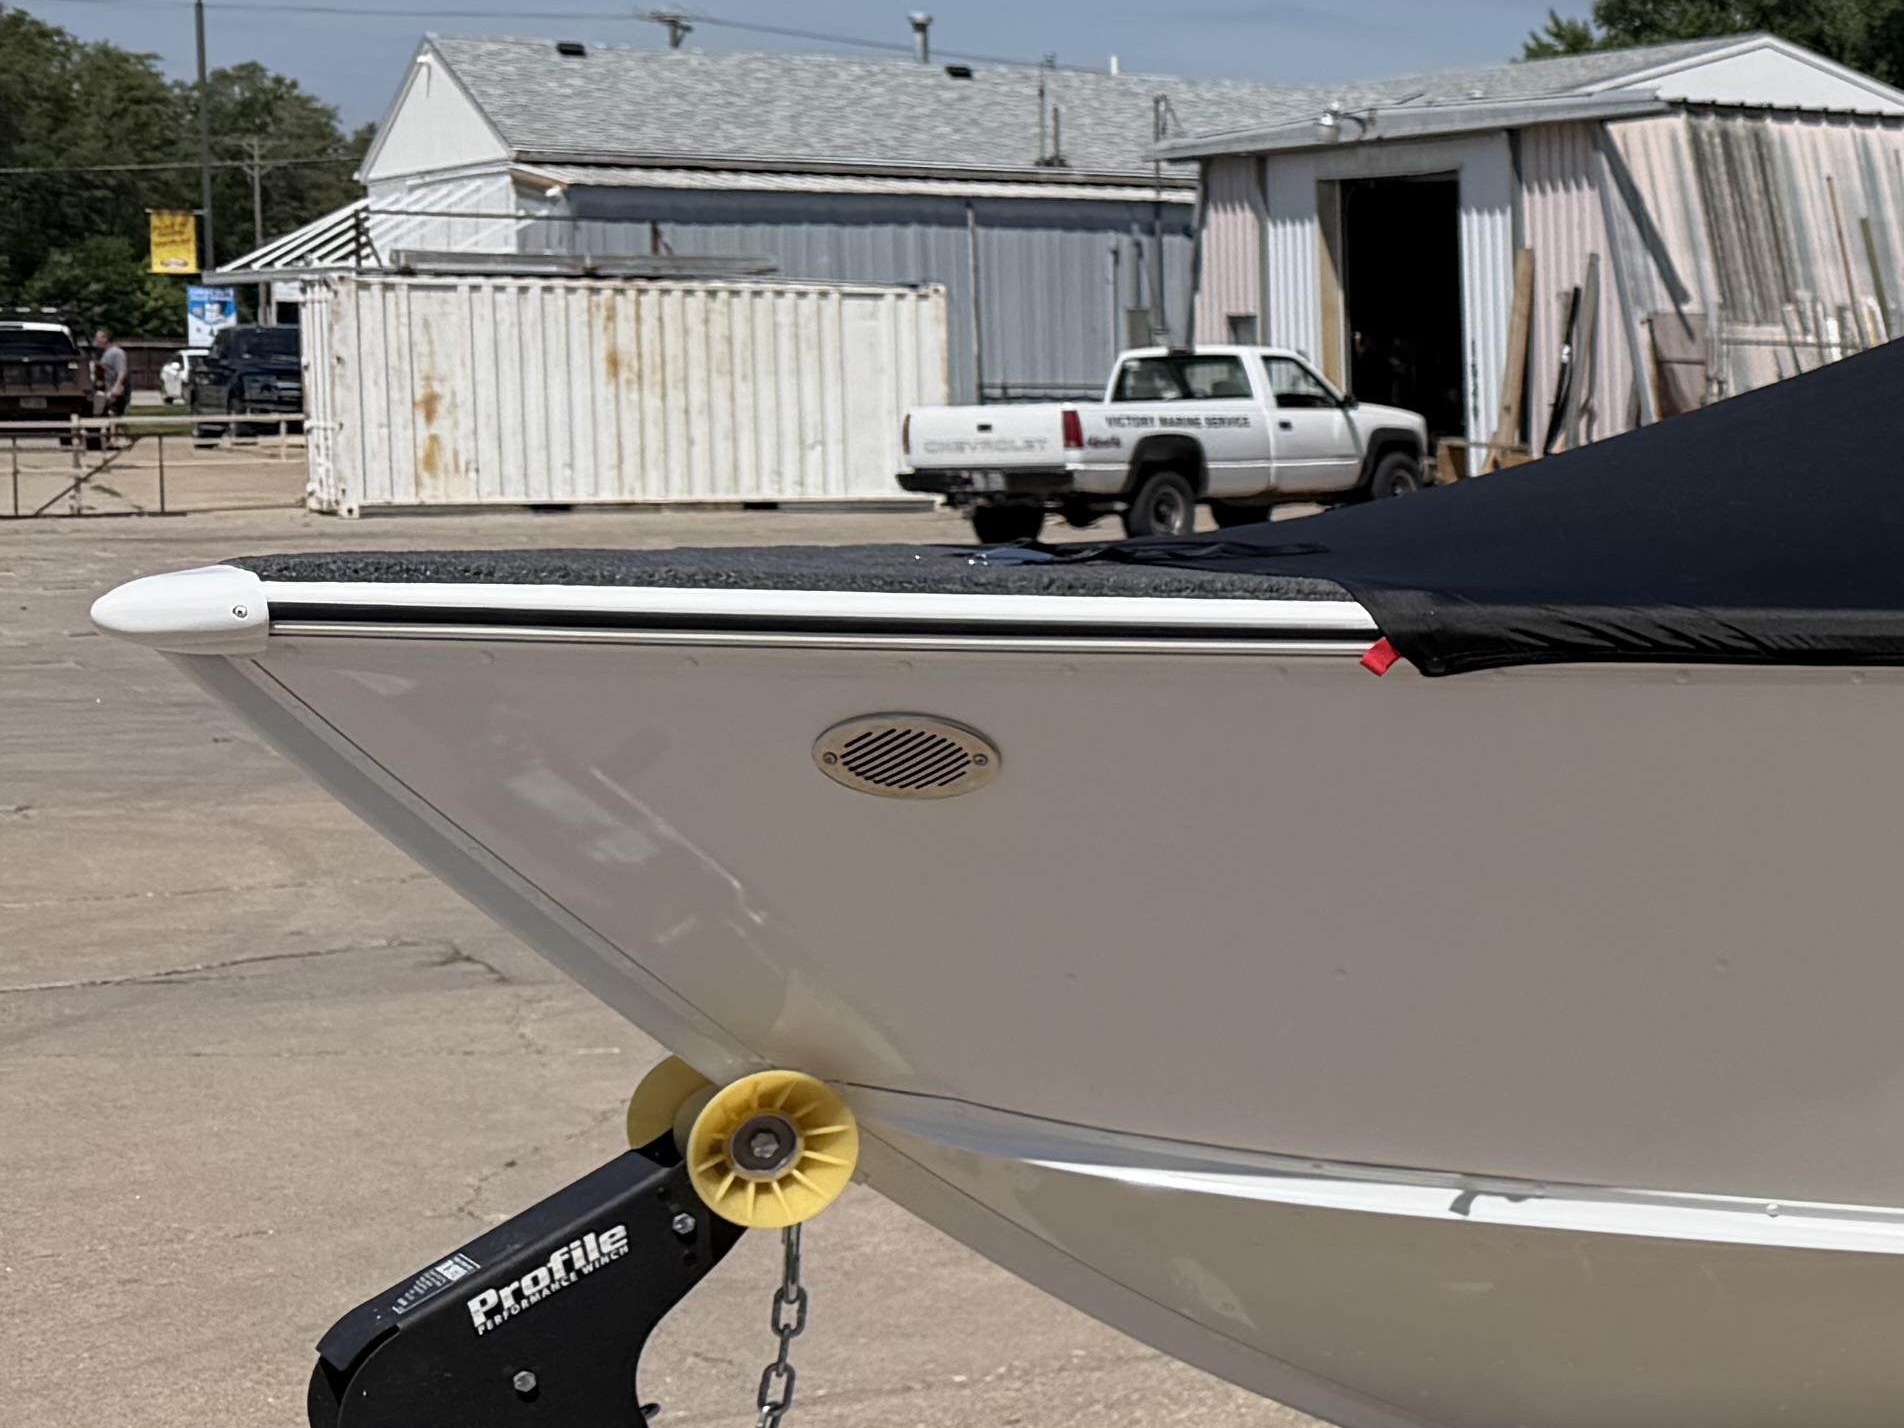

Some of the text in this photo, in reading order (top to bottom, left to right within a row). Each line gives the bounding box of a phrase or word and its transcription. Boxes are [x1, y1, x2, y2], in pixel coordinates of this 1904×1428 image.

[1105, 414, 1155, 428] VICTORY
[467, 1224, 628, 1328] Profile
[477, 1272, 578, 1336] PERFORMANCE
[582, 1244, 629, 1275] WINCH
